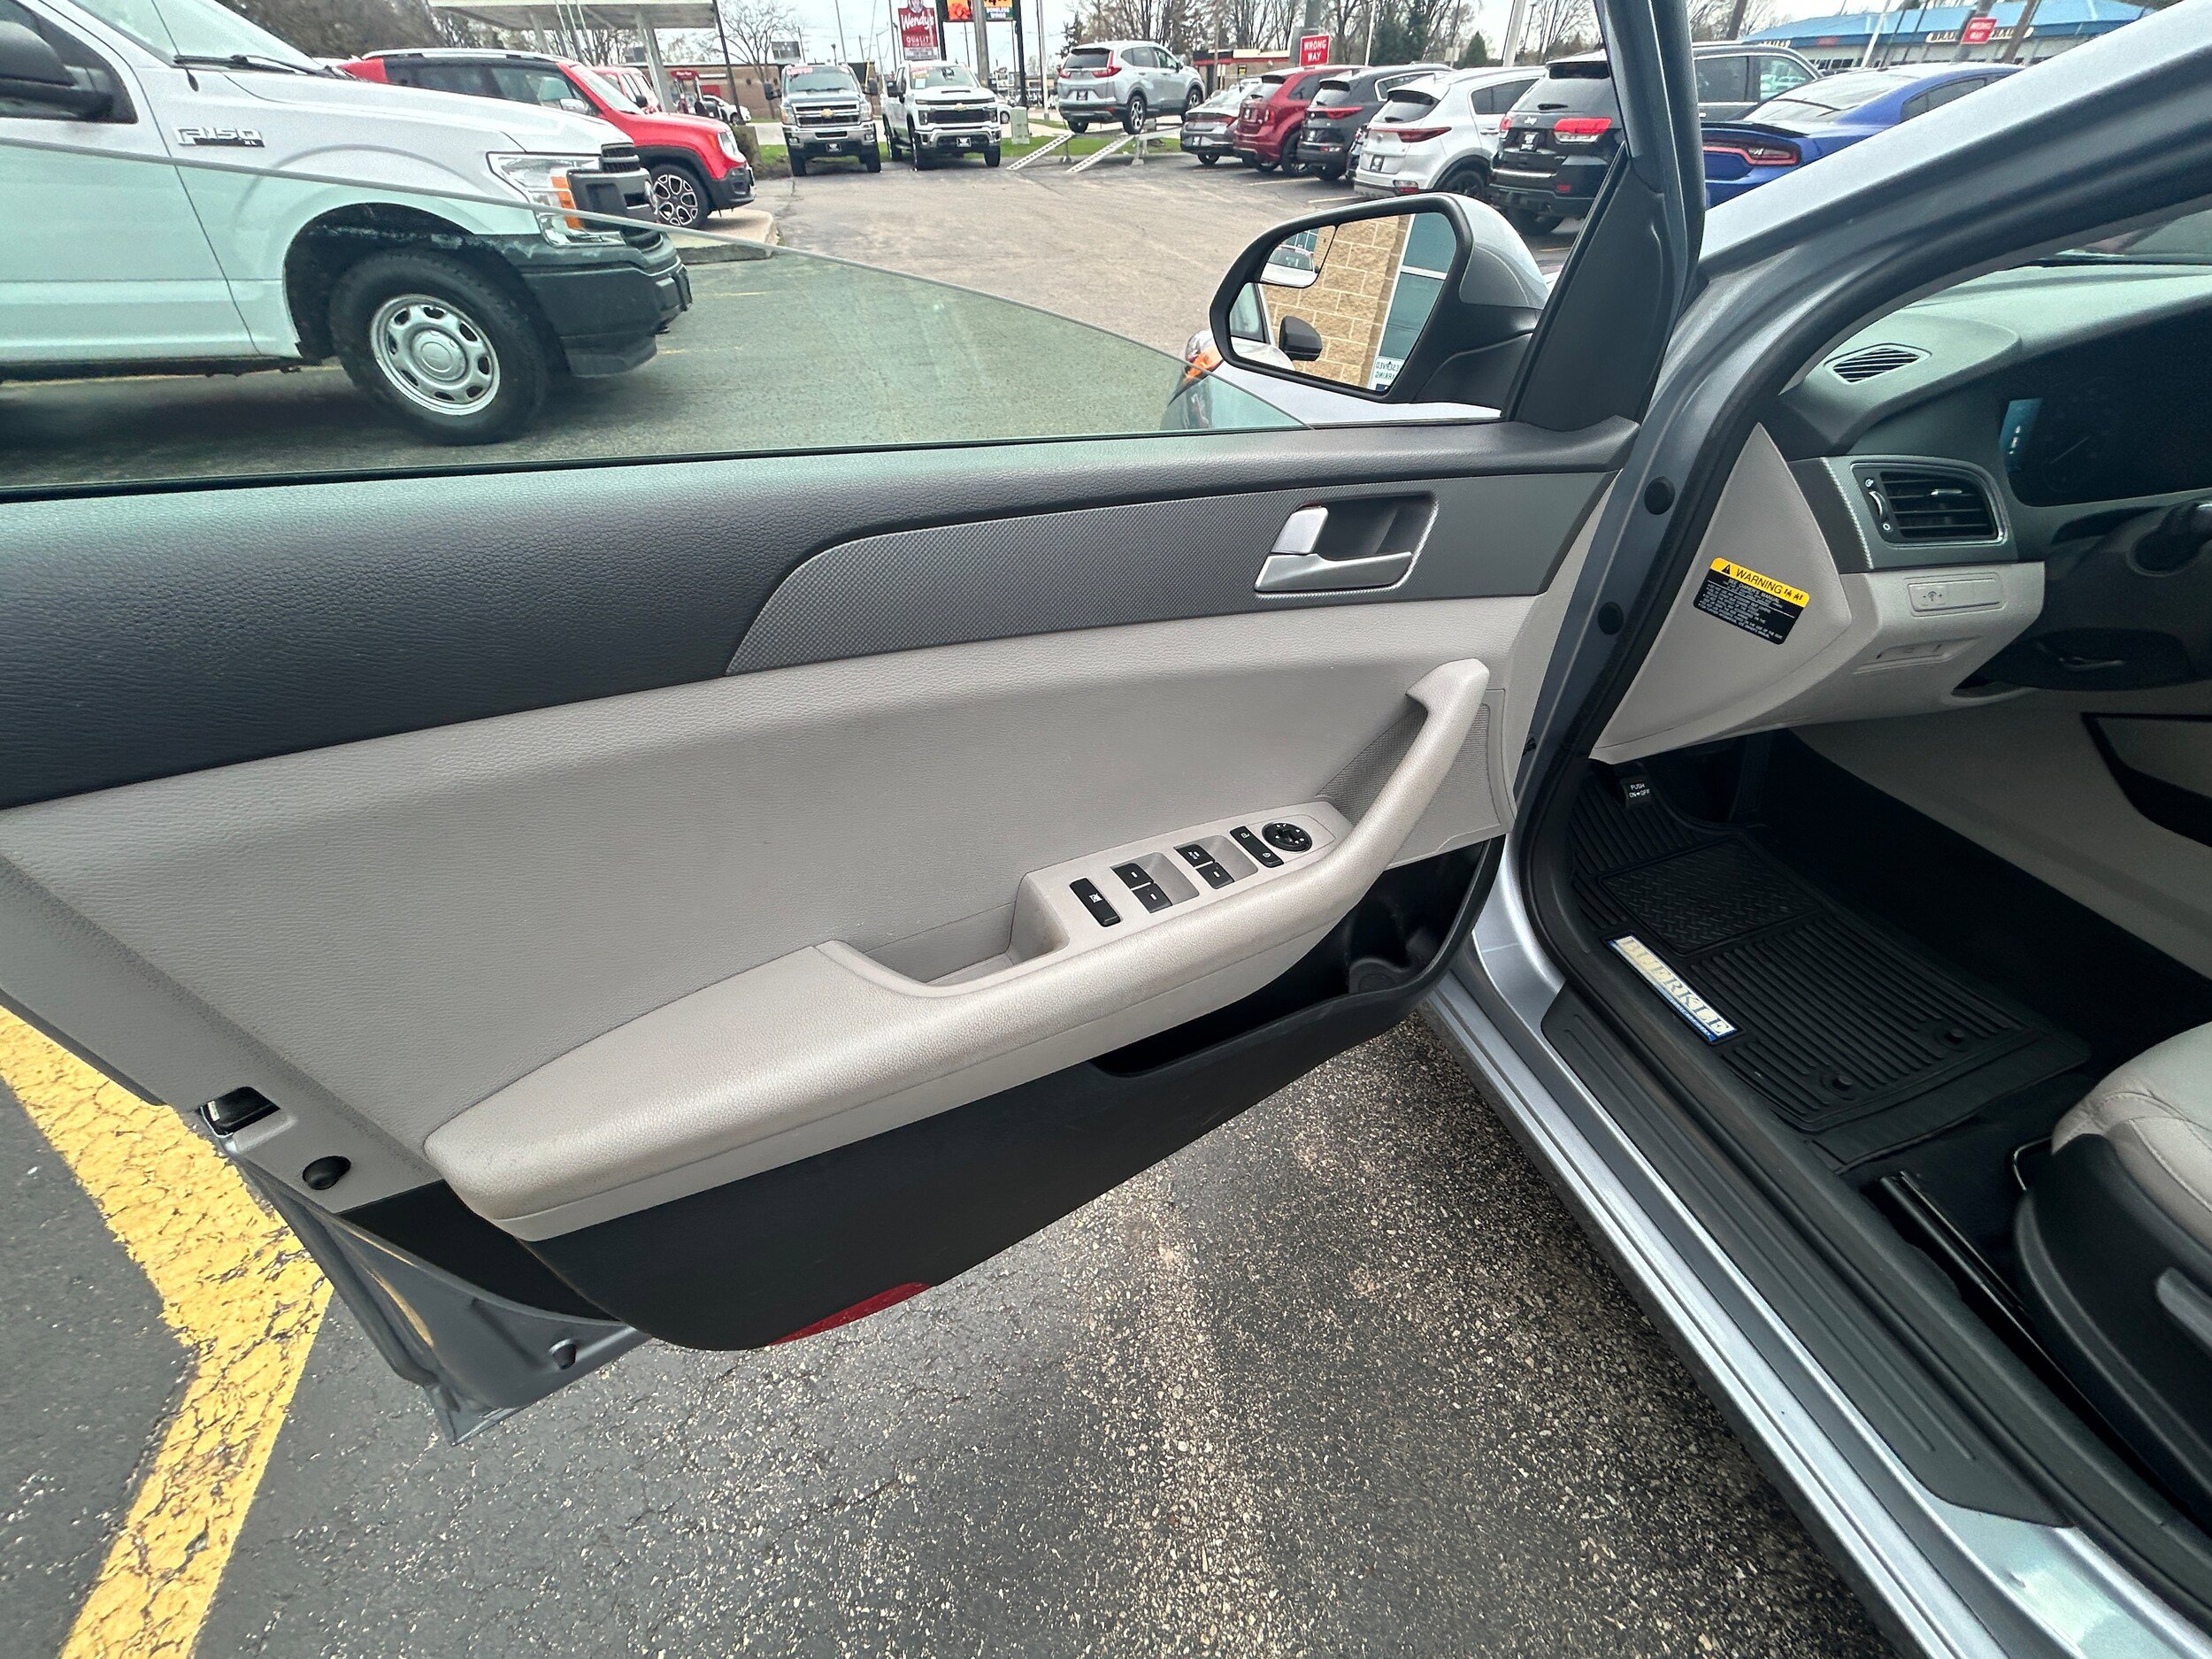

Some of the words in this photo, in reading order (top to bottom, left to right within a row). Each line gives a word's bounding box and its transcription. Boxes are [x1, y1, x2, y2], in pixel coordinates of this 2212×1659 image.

[901, 11, 934, 31] Wendy's
[1303, 39, 1327, 51] WRONG
[1307, 51, 1322, 62] WAY
[1735, 568, 1784, 594] WARNING
[1619, 938, 1731, 1034] BUERKLE
